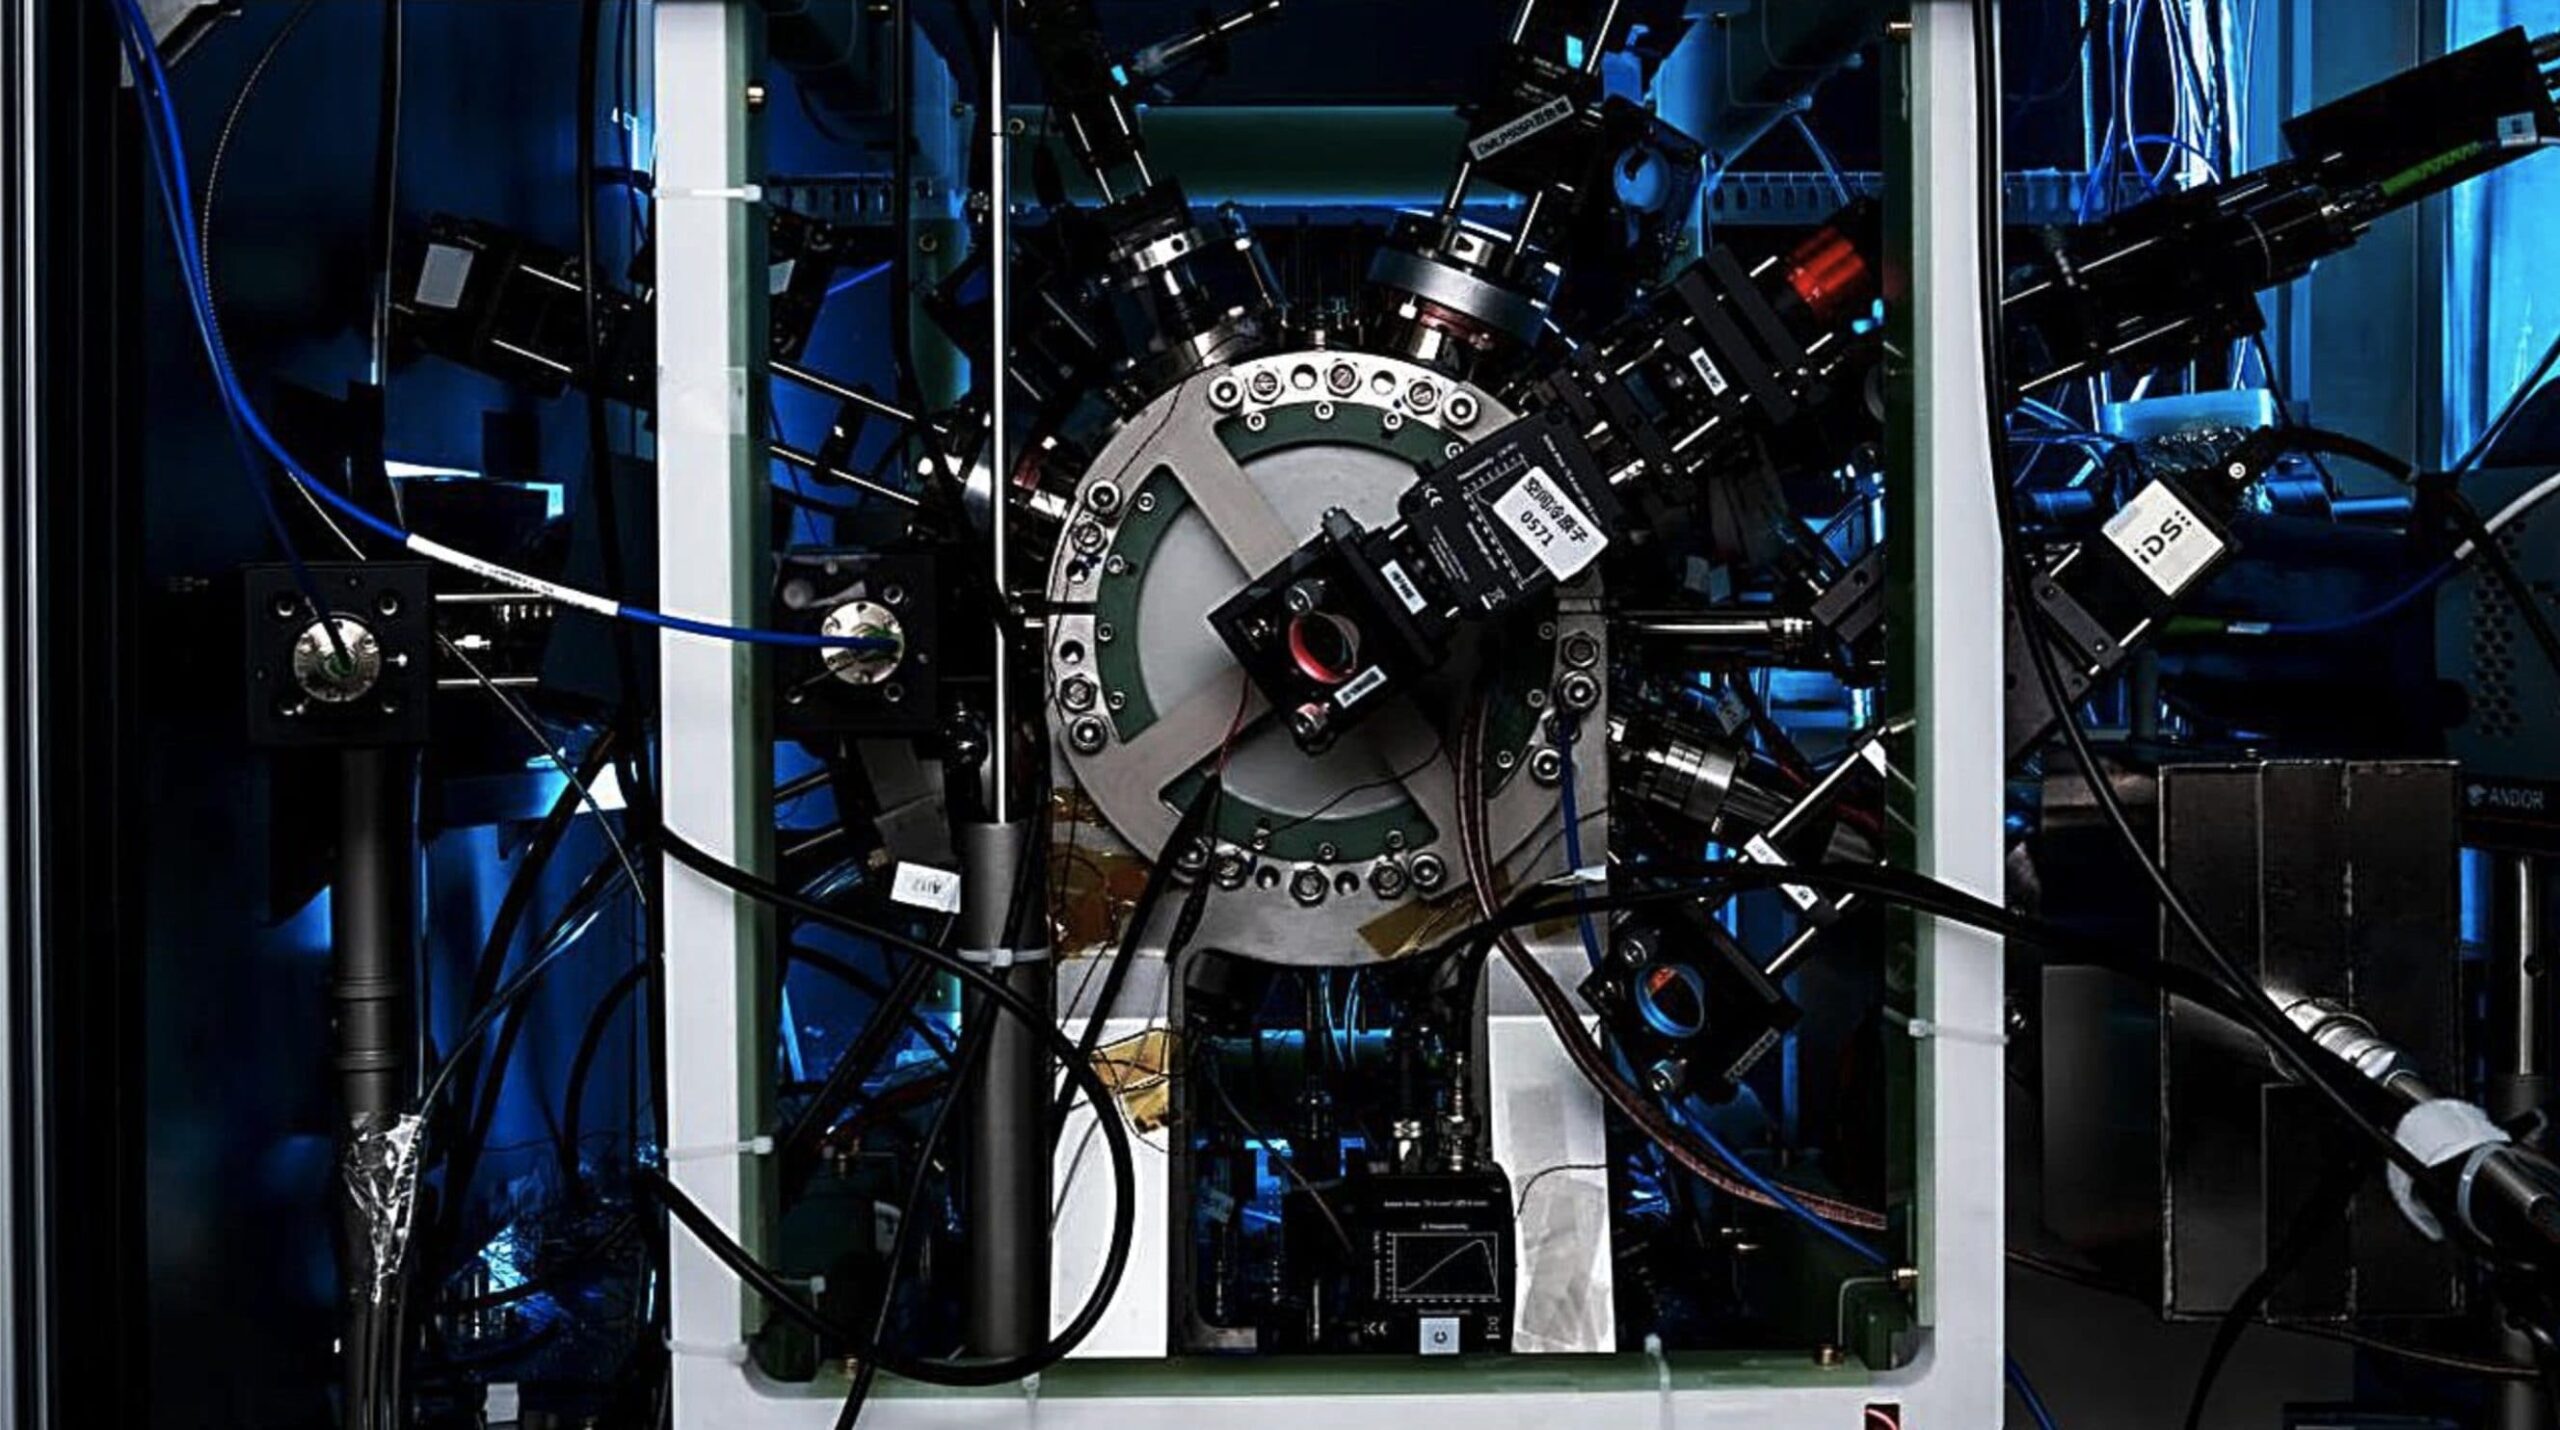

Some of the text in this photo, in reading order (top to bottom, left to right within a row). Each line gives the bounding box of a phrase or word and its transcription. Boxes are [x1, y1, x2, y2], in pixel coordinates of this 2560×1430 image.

[1522, 476, 1588, 543] 空间冷原子
[1520, 510, 1554, 547] 0571
[2489, 787, 2544, 810] ANDOR
